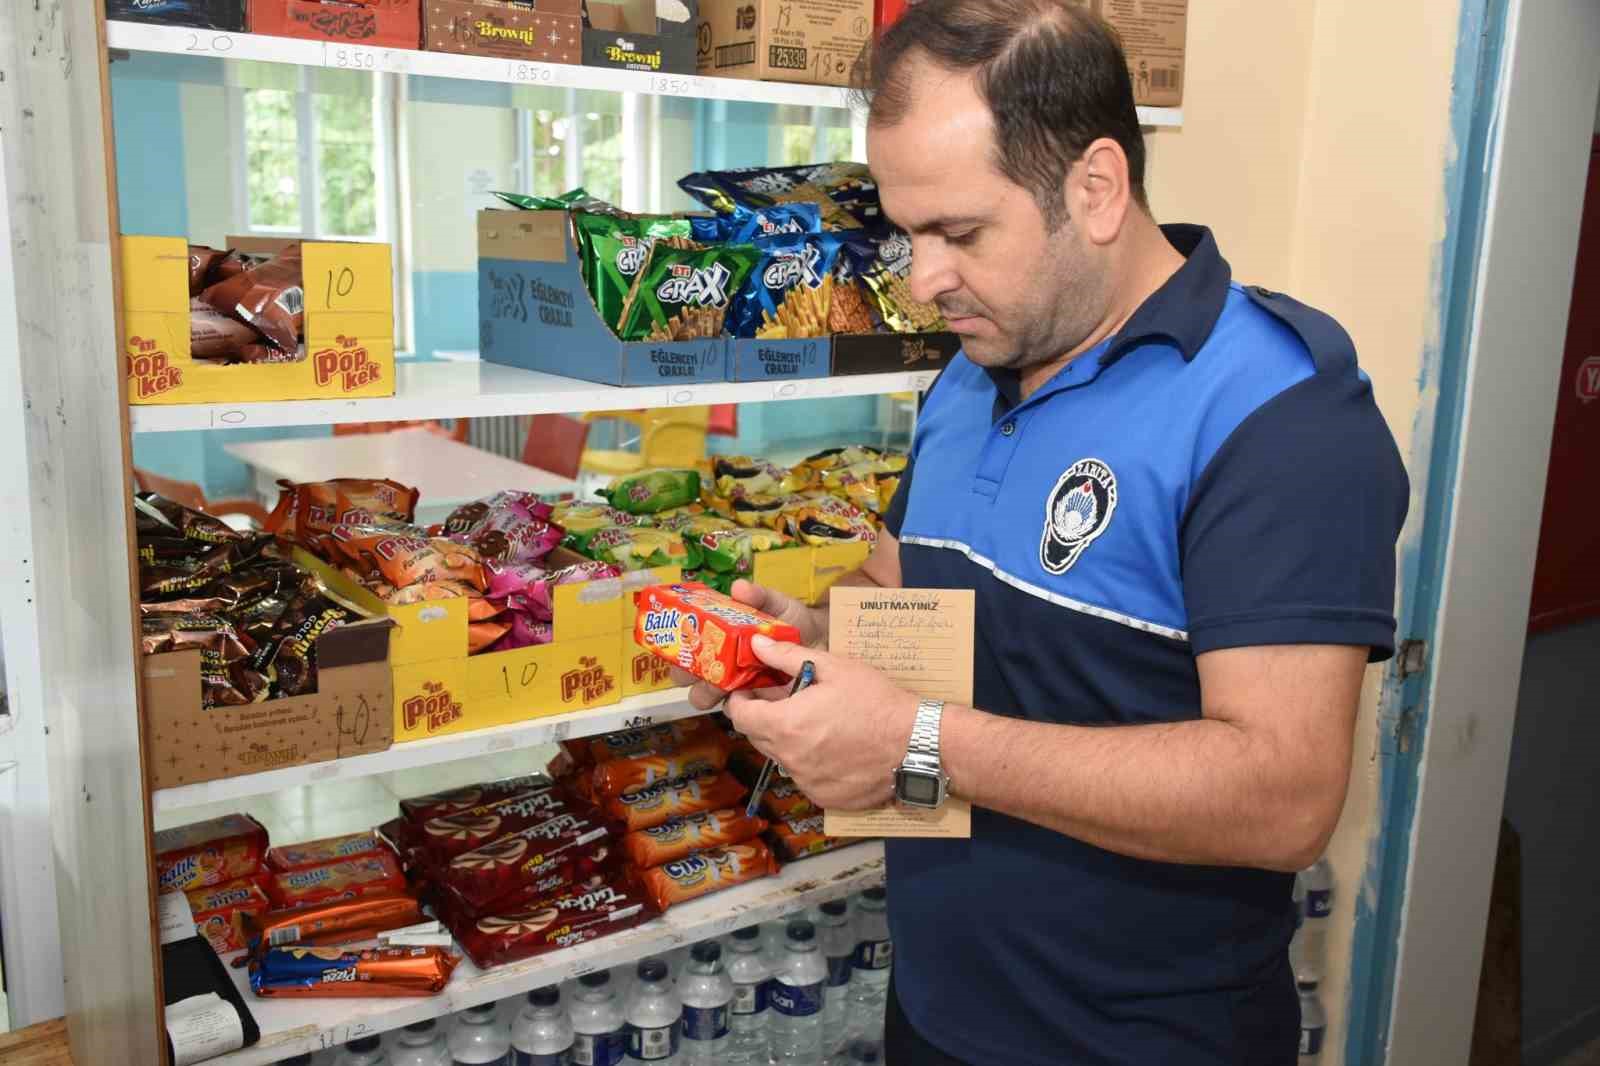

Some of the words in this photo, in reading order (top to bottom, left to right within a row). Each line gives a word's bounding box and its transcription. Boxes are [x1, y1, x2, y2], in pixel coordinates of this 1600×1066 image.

[185, 33, 233, 51] 20
[473, 20, 535, 45] Browni
[606, 47, 661, 70] Browni
[764, 243, 823, 290] CRAX
[327, 267, 354, 309] 10
[657, 264, 731, 309] CRAX
[210, 409, 247, 428] 10
[645, 610, 681, 632] Balık
[501, 662, 538, 698] 10
[499, 794, 563, 818] Tutku
[556, 887, 627, 912] Tutku
